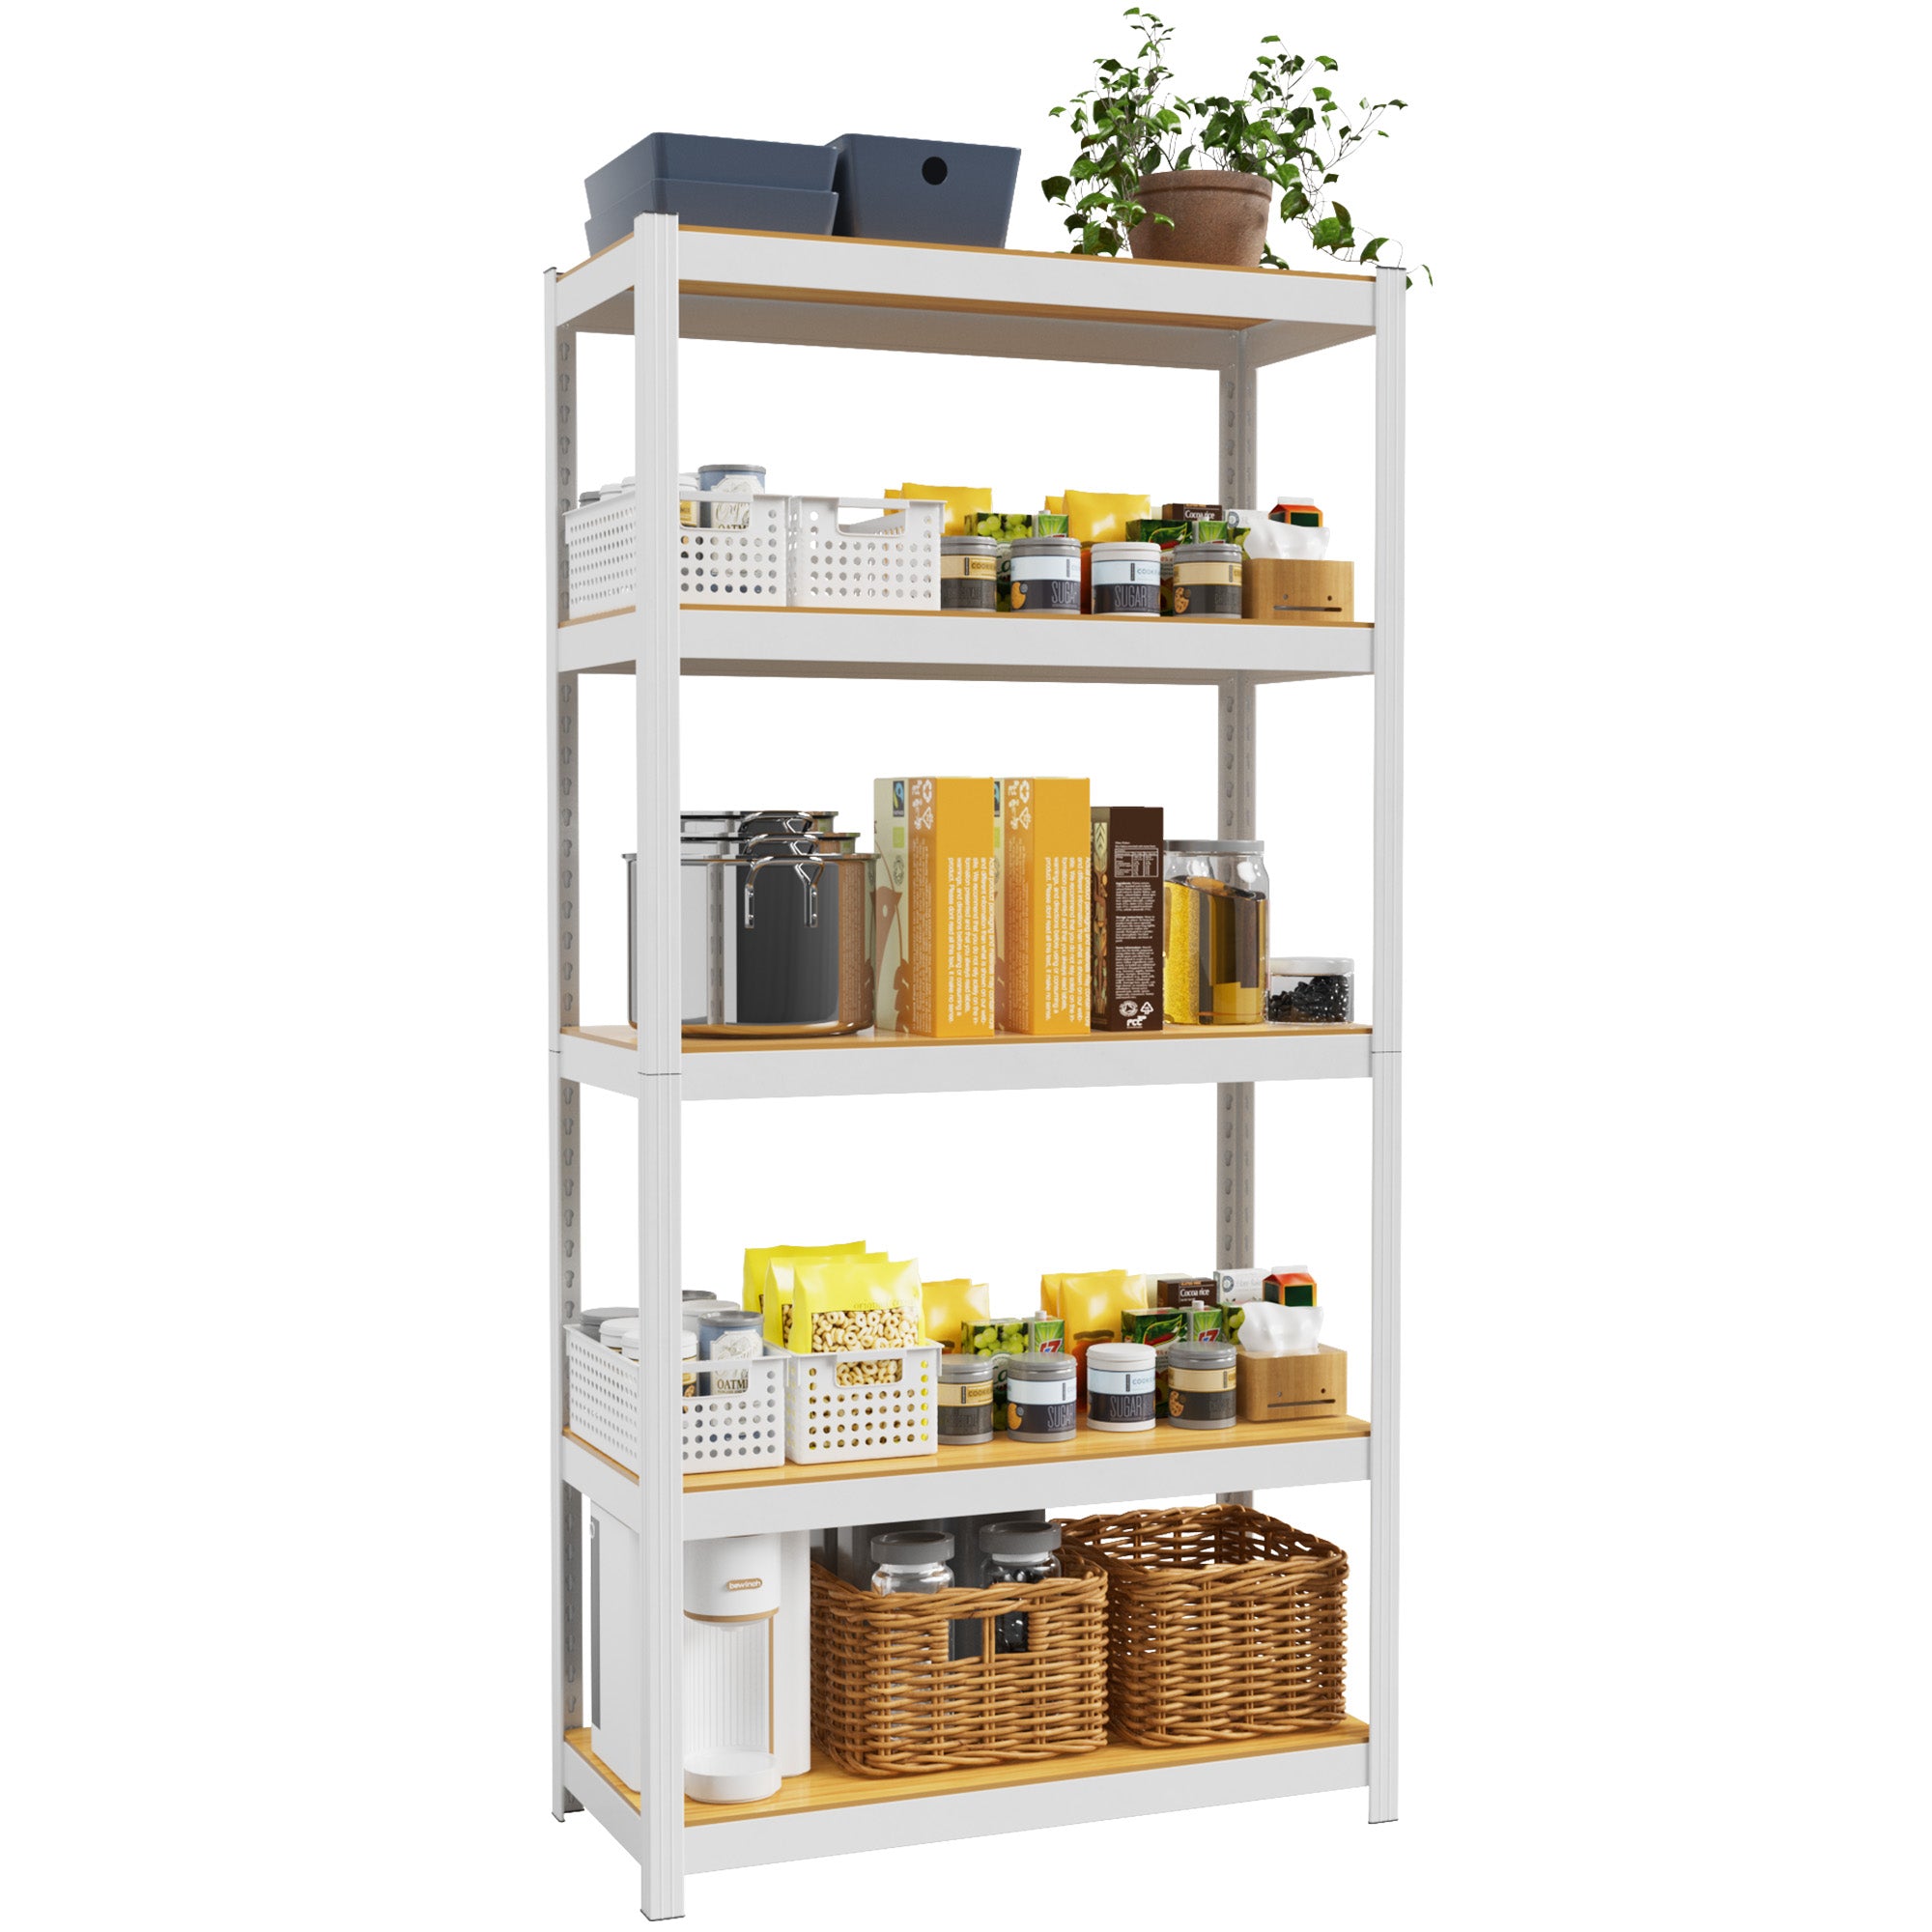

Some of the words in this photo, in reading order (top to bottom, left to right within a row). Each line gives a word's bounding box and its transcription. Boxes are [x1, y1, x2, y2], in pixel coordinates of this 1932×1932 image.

[1114, 585, 1148, 608] SUGAR
[1180, 1289, 1199, 1297] Cocoa
[1110, 1396, 1142, 1418] SUGAR
